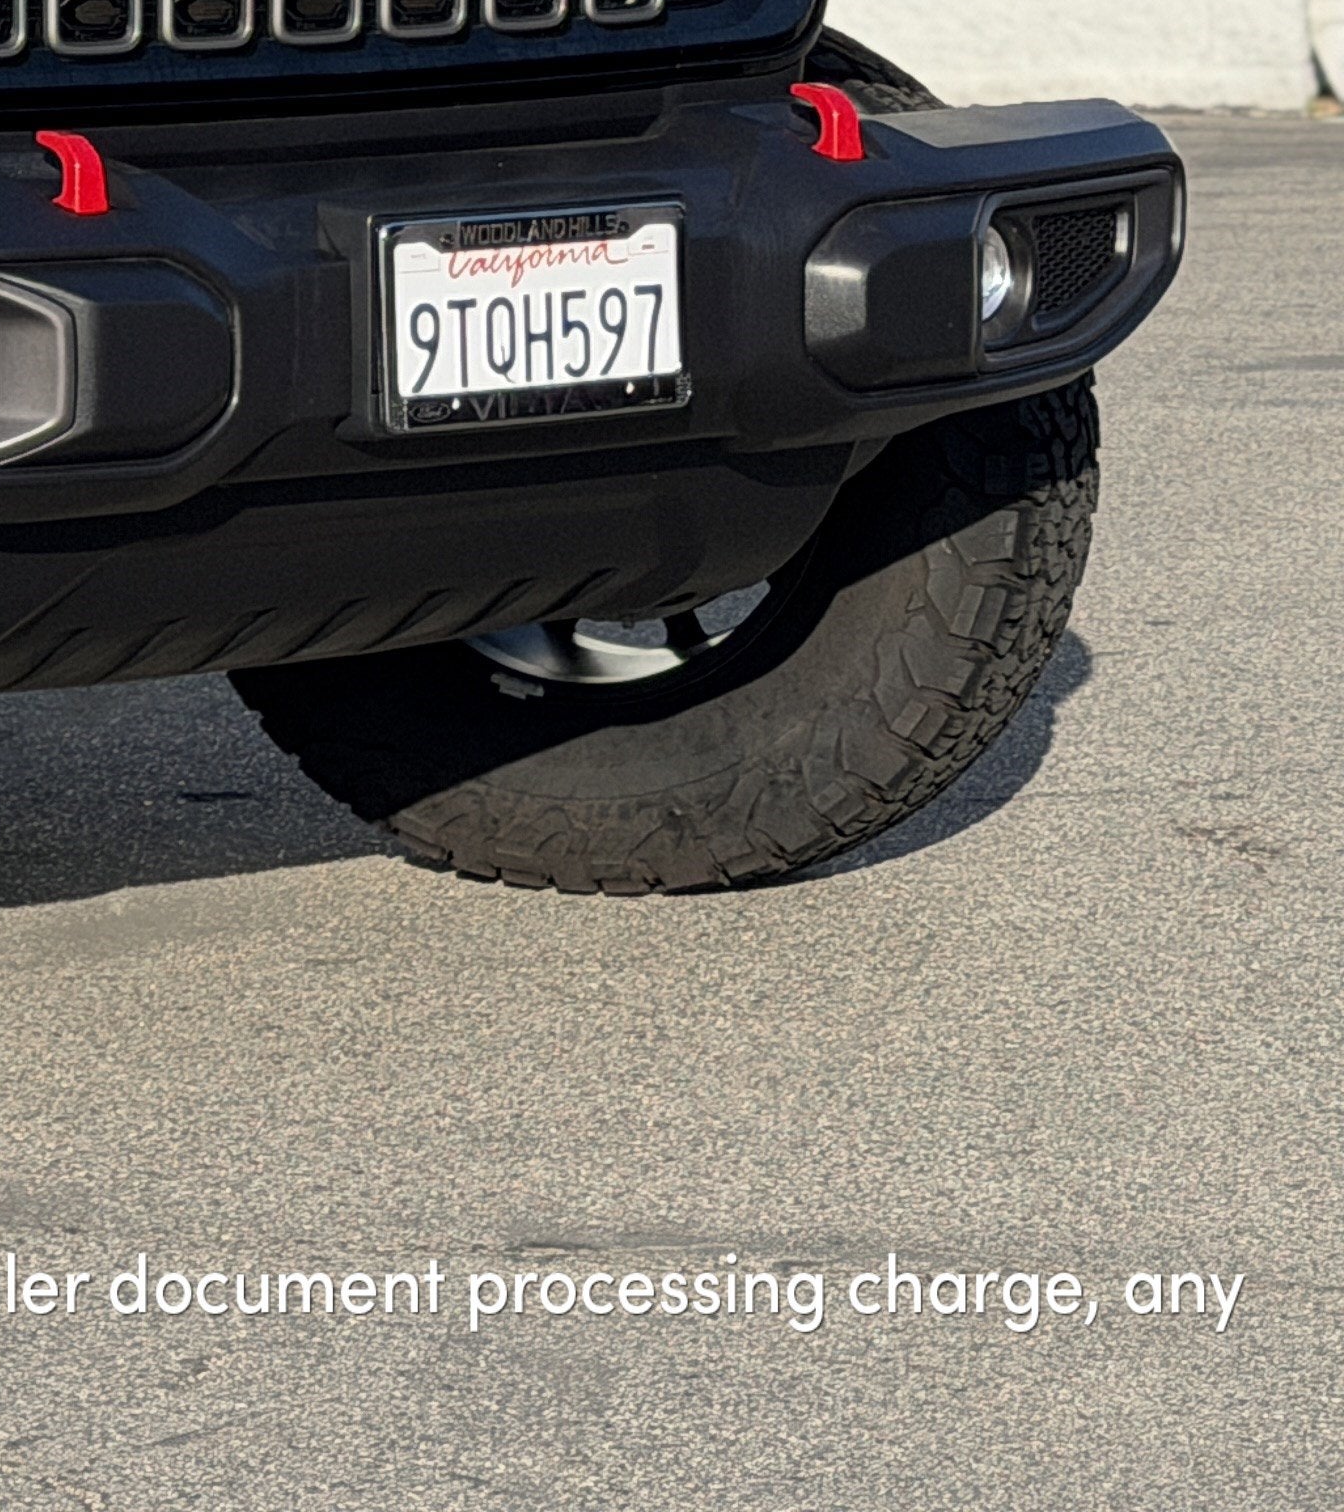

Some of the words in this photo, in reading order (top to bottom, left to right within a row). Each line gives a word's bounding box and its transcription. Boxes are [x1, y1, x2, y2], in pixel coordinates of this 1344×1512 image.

[461, 219, 566, 247] WOODLAND
[568, 214, 619, 239] HILLS
[448, 239, 629, 289] California
[408, 283, 663, 394] 9TQH597
